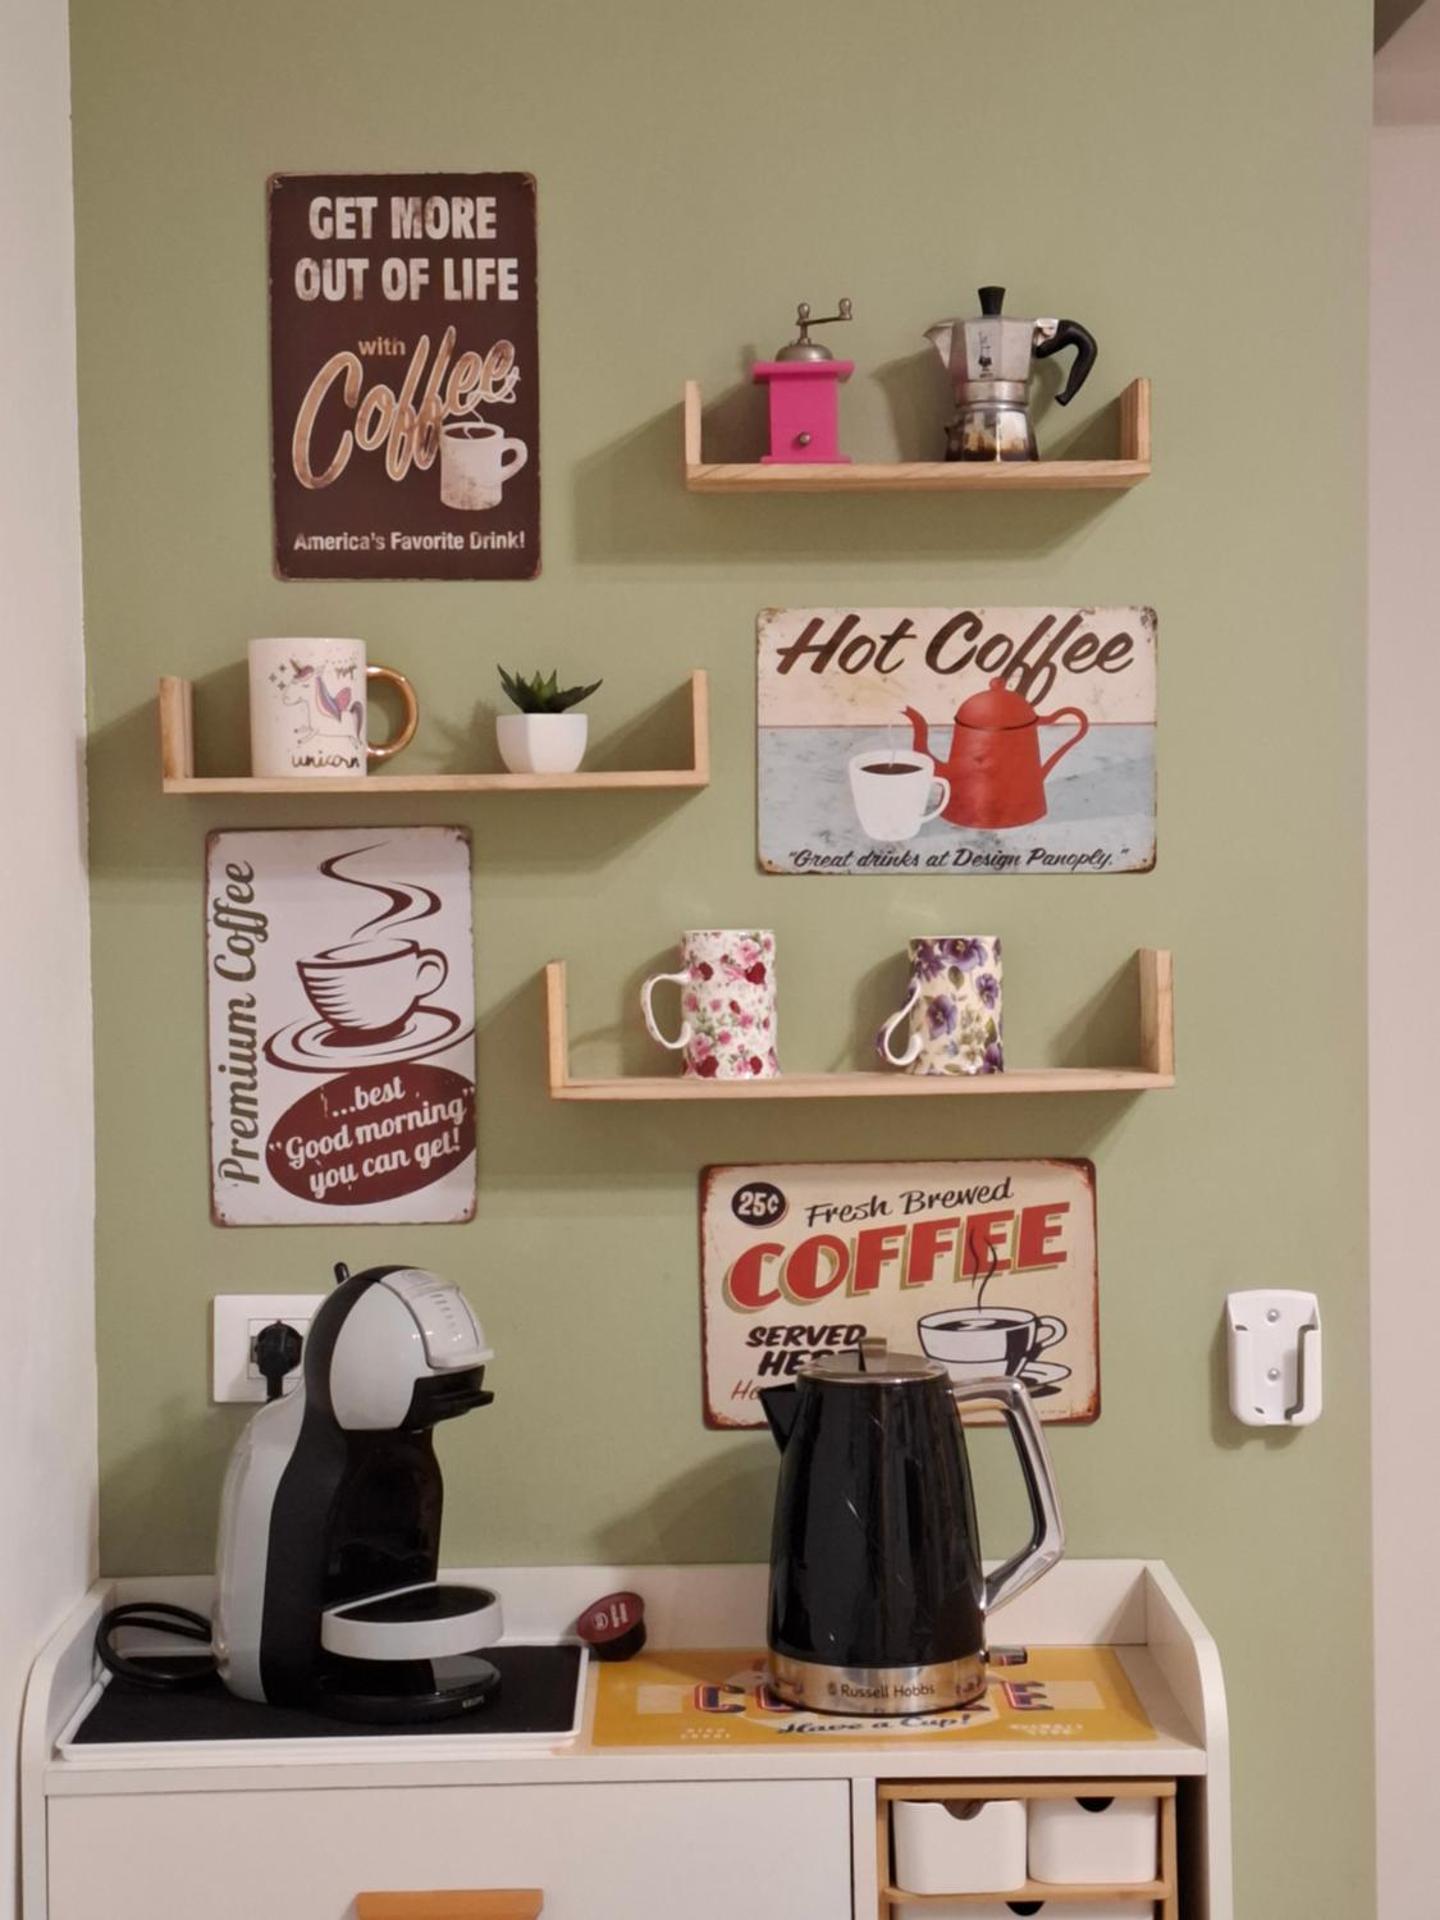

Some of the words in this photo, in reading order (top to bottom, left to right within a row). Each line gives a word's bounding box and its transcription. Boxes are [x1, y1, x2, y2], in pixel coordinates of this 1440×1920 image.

[308, 196, 378, 240] GET
[391, 196, 497, 240] MORE
[294, 257, 370, 301] OUT
[381, 257, 430, 301] OF
[443, 257, 519, 301] LIFE
[358, 338, 406, 356] with
[292, 325, 521, 489] Coffee
[294, 532, 385, 550] America's
[390, 531, 464, 549] Favorite
[469, 531, 525, 549] Drink!
[776, 613, 917, 675] Hot
[925, 610, 1134, 706] Coffee
[291, 750, 360, 768] unicorn
[789, 849, 854, 867] "Great
[856, 849, 920, 867] drinks
[926, 850, 950, 867] at
[952, 848, 1021, 870] Design
[213, 861, 268, 982] Coffee
[217, 993, 260, 1185] Premium
[309, 1163, 359, 1199] you
[362, 1149, 411, 1177] can
[414, 1127, 461, 1169] get!
[805, 1193, 891, 1228] Fresh
[900, 1177, 1014, 1216] Brewed
[724, 1202, 1071, 1312] COFFEE
[746, 1324, 867, 1347] SERVED
[758, 1350, 860, 1376] HE
[841, 1683, 889, 1698] Russell
[894, 1684, 935, 1697] Hobbs
[901, 1713, 971, 1729] Cup!
